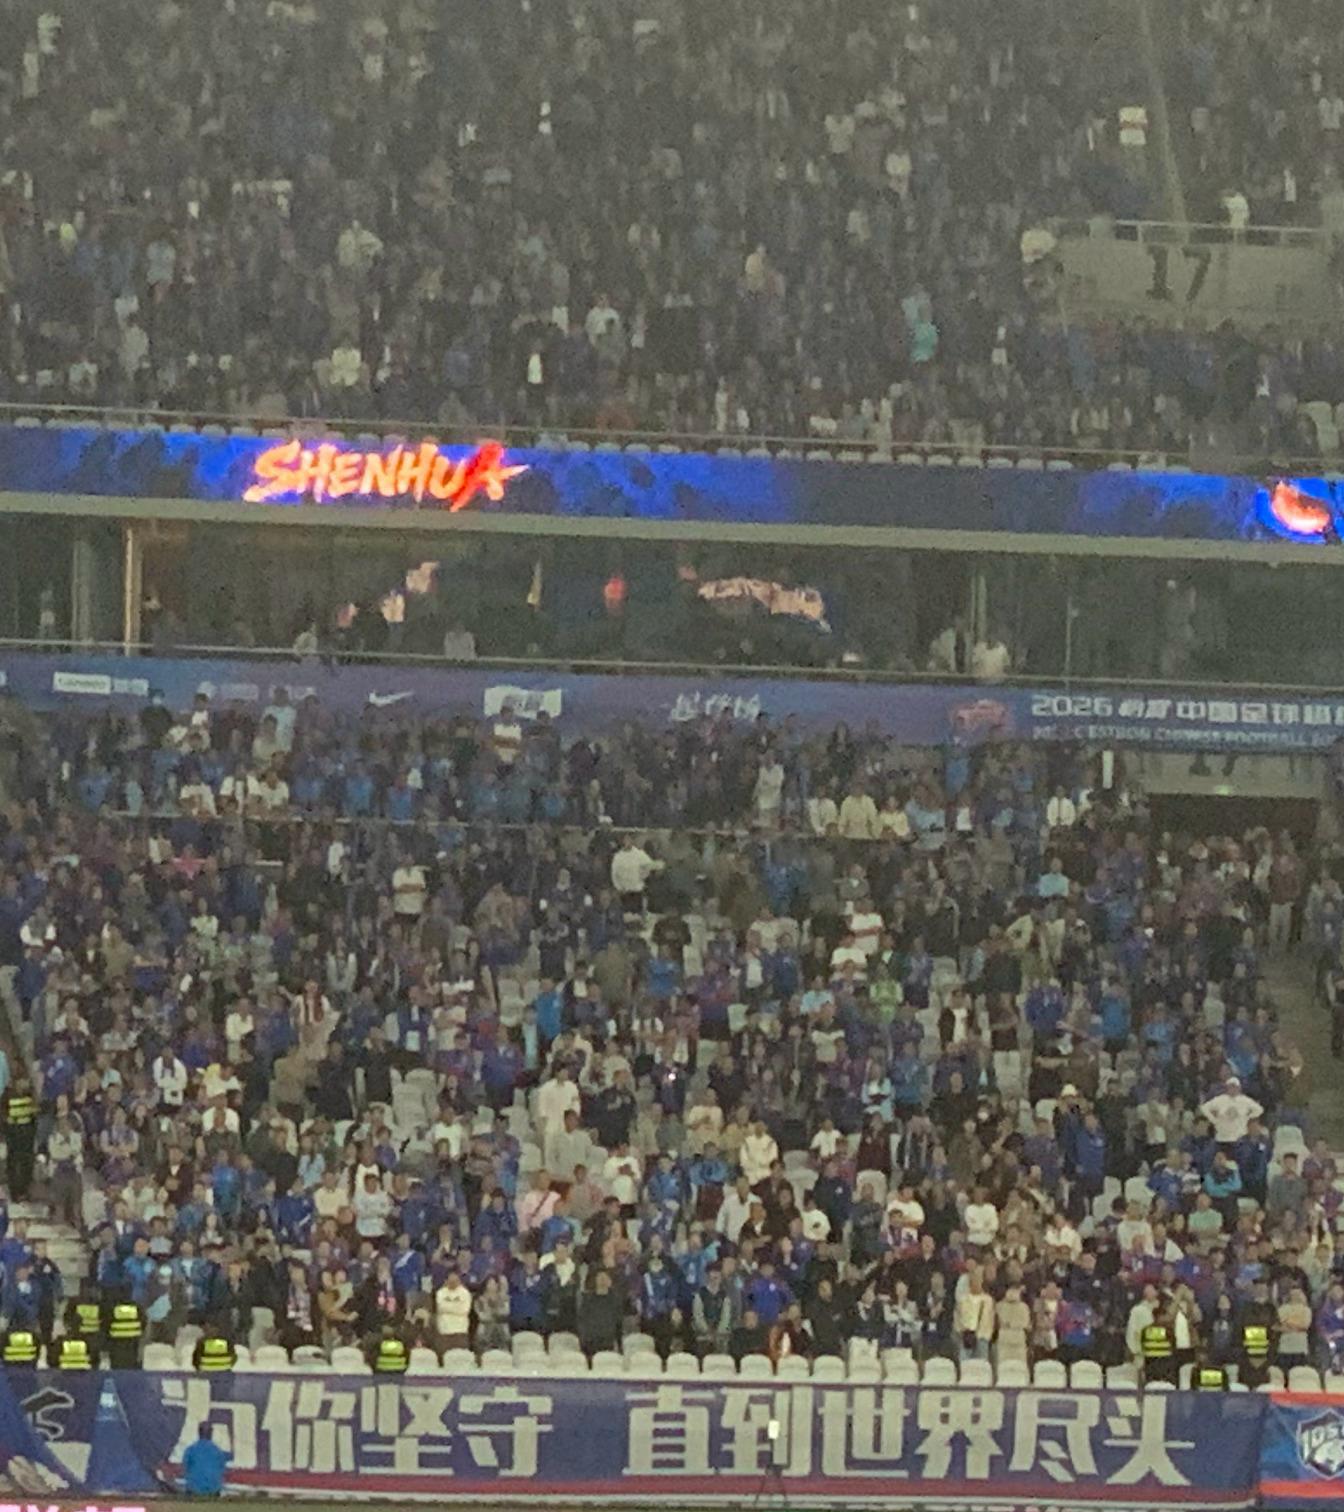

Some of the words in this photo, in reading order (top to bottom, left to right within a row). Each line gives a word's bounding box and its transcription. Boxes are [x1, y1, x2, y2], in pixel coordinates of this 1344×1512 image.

[1146, 246, 1211, 301] 17
[243, 439, 530, 512] SHENHUA
[1031, 696, 1112, 717] 2026
[161, 1378, 553, 1478] 为你坚守
[621, 1384, 1194, 1486] 直到世界尽头
